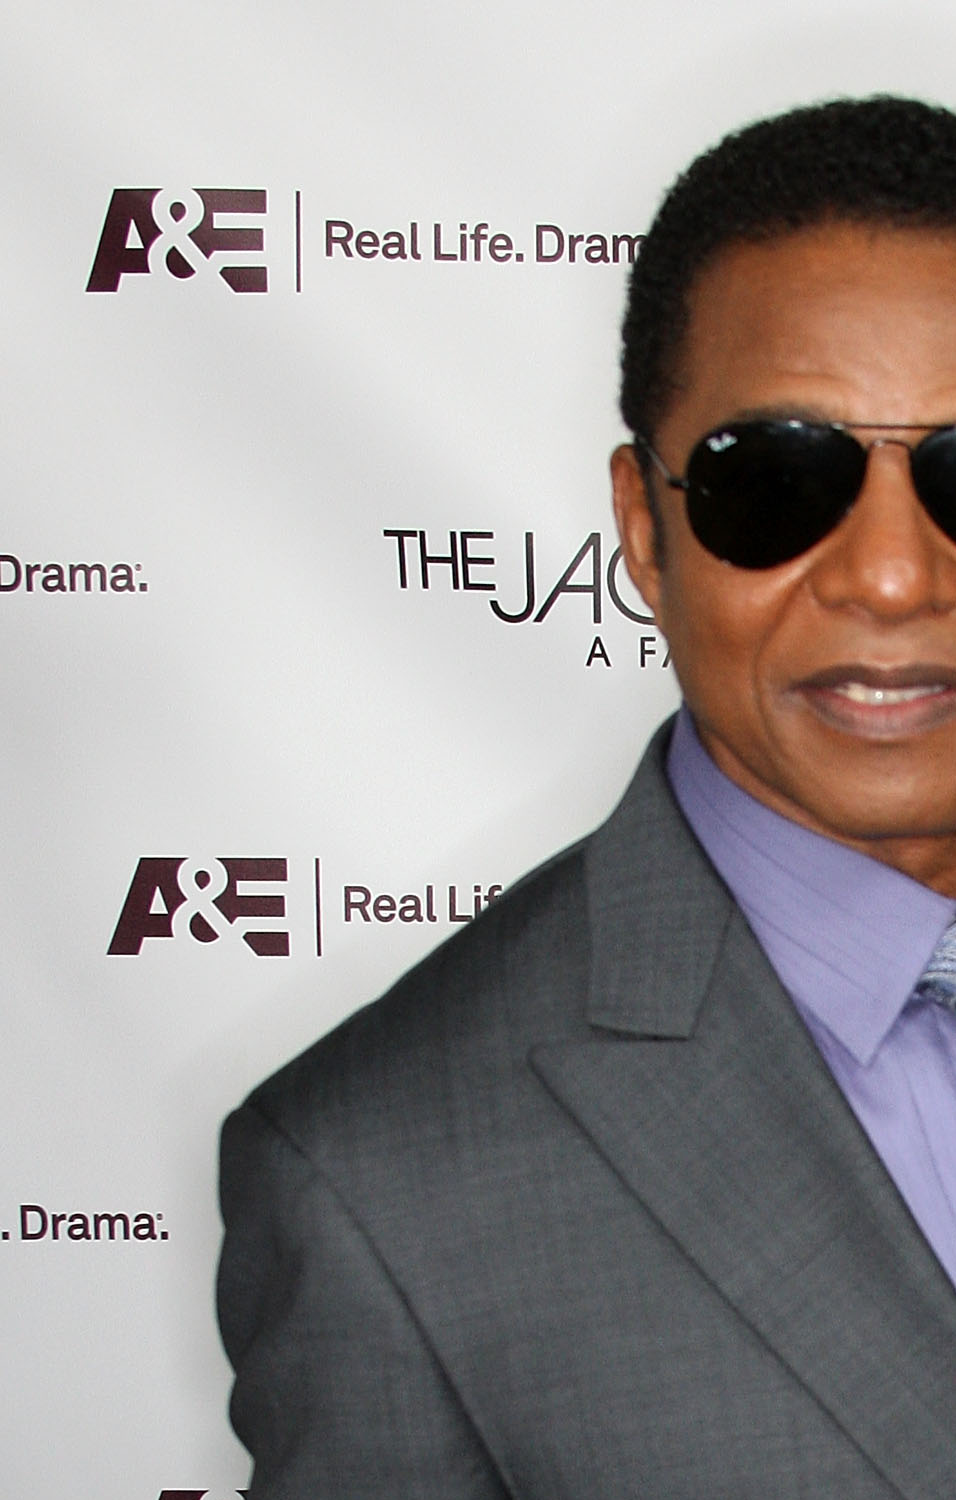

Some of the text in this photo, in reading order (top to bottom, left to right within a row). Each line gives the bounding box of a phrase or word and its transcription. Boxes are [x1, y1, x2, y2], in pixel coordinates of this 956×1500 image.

[86, 189, 267, 292] A&E
[326, 220, 421, 260] Real
[434, 223, 523, 262] Life.
[384, 530, 495, 590] THE
[586, 637, 611, 666] A
[107, 858, 289, 956] A&E
[344, 885, 436, 922] Real
